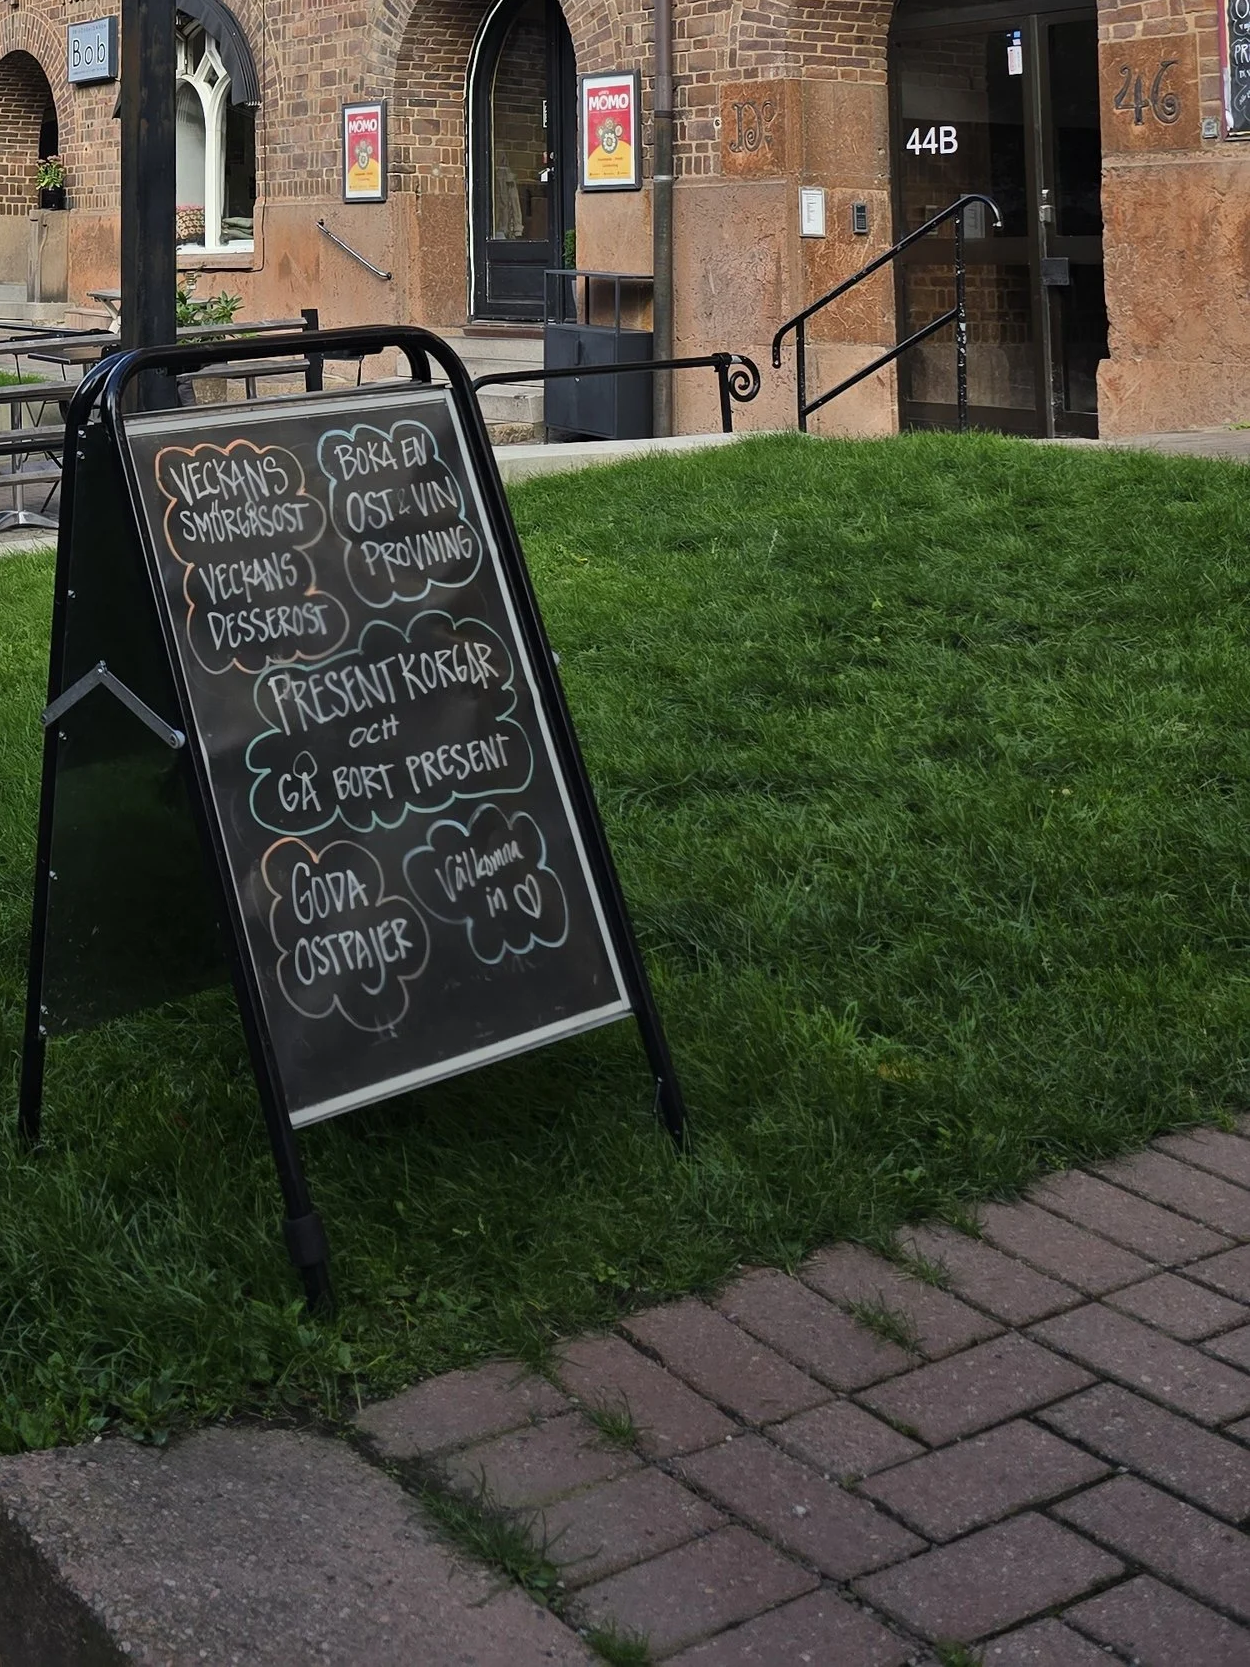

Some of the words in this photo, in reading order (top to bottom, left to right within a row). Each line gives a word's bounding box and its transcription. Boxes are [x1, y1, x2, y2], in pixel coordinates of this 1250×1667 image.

[72, 34, 106, 68] Bob
[588, 93, 629, 111] MOMO
[1113, 59, 1181, 127] 46
[348, 118, 378, 134] MOMO
[905, 125, 959, 156] 44B
[169, 456, 289, 507] VECKANS
[334, 441, 398, 481] BOKA
[401, 433, 428, 468] EN
[179, 499, 310, 544] SMÖRGÅSOST
[346, 489, 395, 533] OST
[397, 488, 411, 514] &
[410, 476, 458, 517] VIN
[198, 551, 298, 605] VECKANS
[360, 525, 472, 583] PROVNING
[207, 602, 328, 651] DESSEROST
[348, 713, 400, 748] OCH
[278, 750, 322, 812] GÅ
[332, 764, 395, 800] BORT
[405, 733, 510, 794] PRESENT
[291, 861, 370, 925] GODA
[485, 886, 508, 918] in
[295, 918, 413, 996] OSTPAJER
